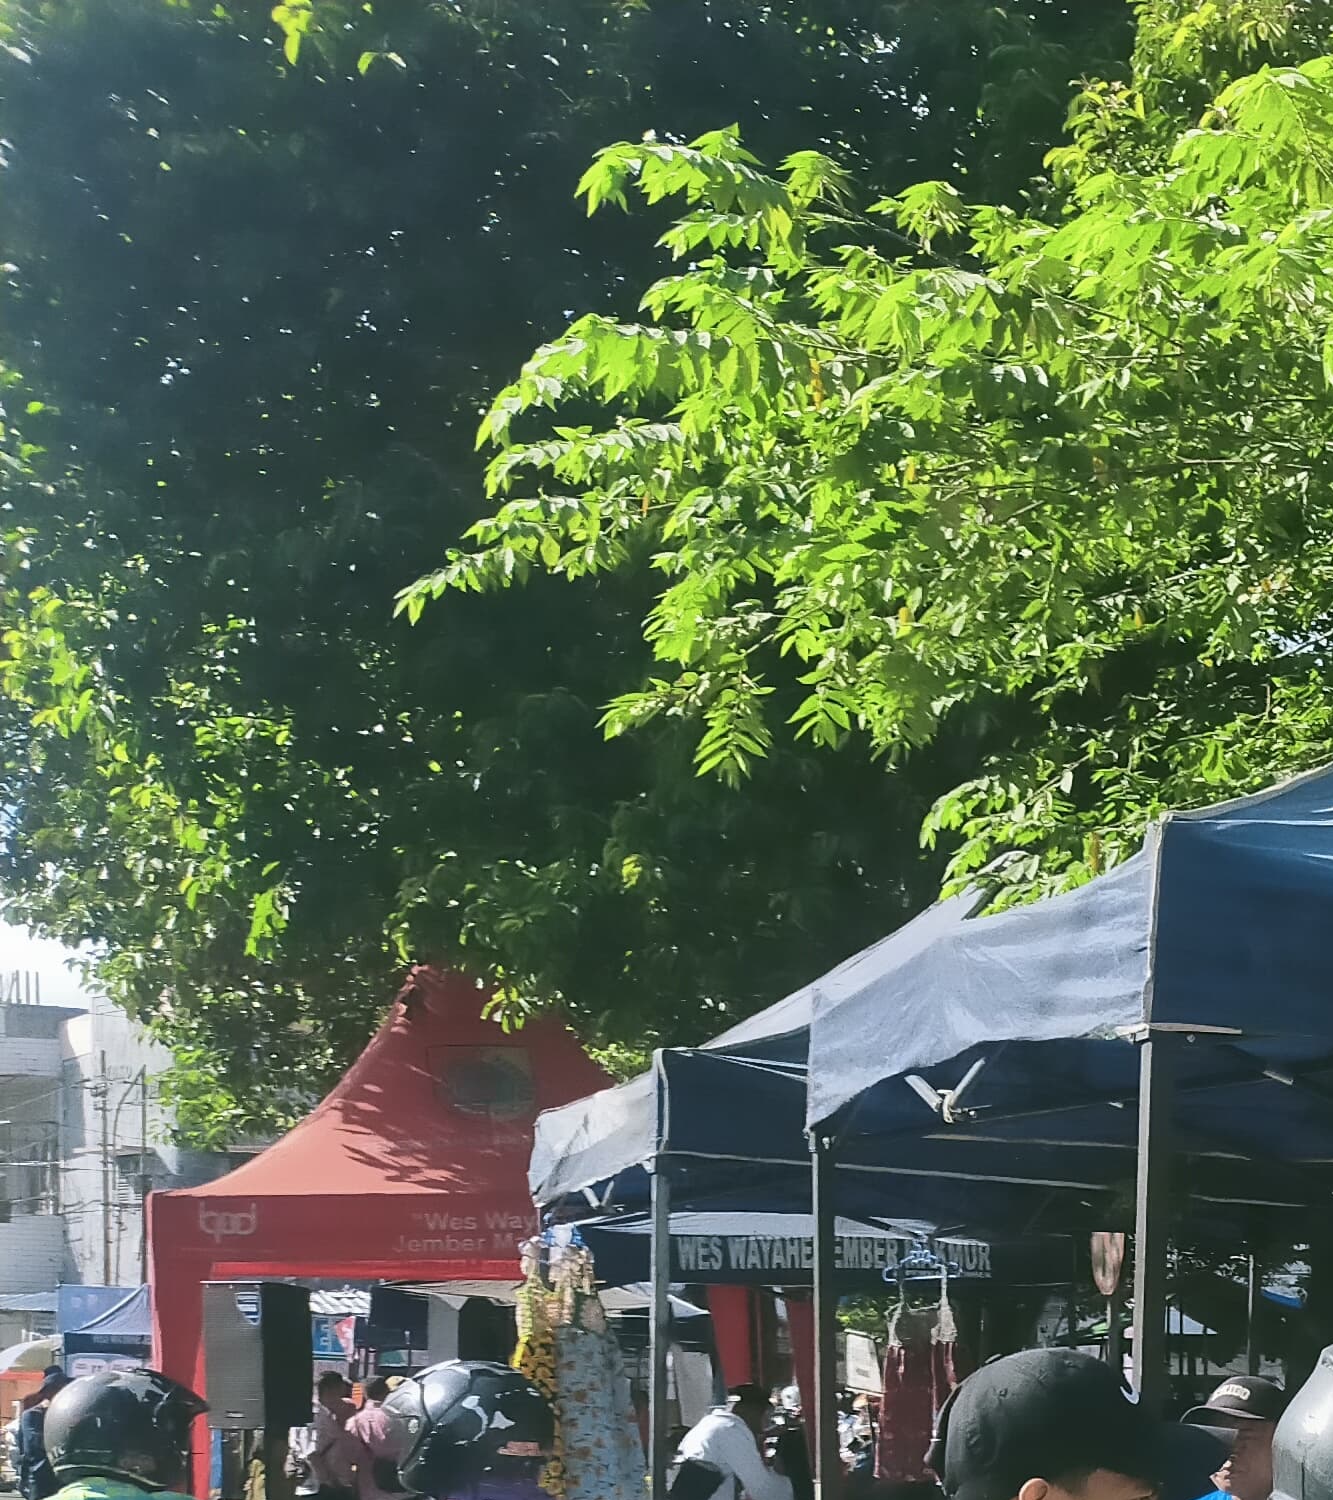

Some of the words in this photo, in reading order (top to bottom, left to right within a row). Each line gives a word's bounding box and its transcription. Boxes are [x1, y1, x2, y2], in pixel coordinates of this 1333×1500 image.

[485, 1210, 540, 1236] Way
[677, 1236, 723, 1271] WES
[727, 1235, 814, 1271] WAYAHE
[835, 1236, 899, 1271] EMBER
